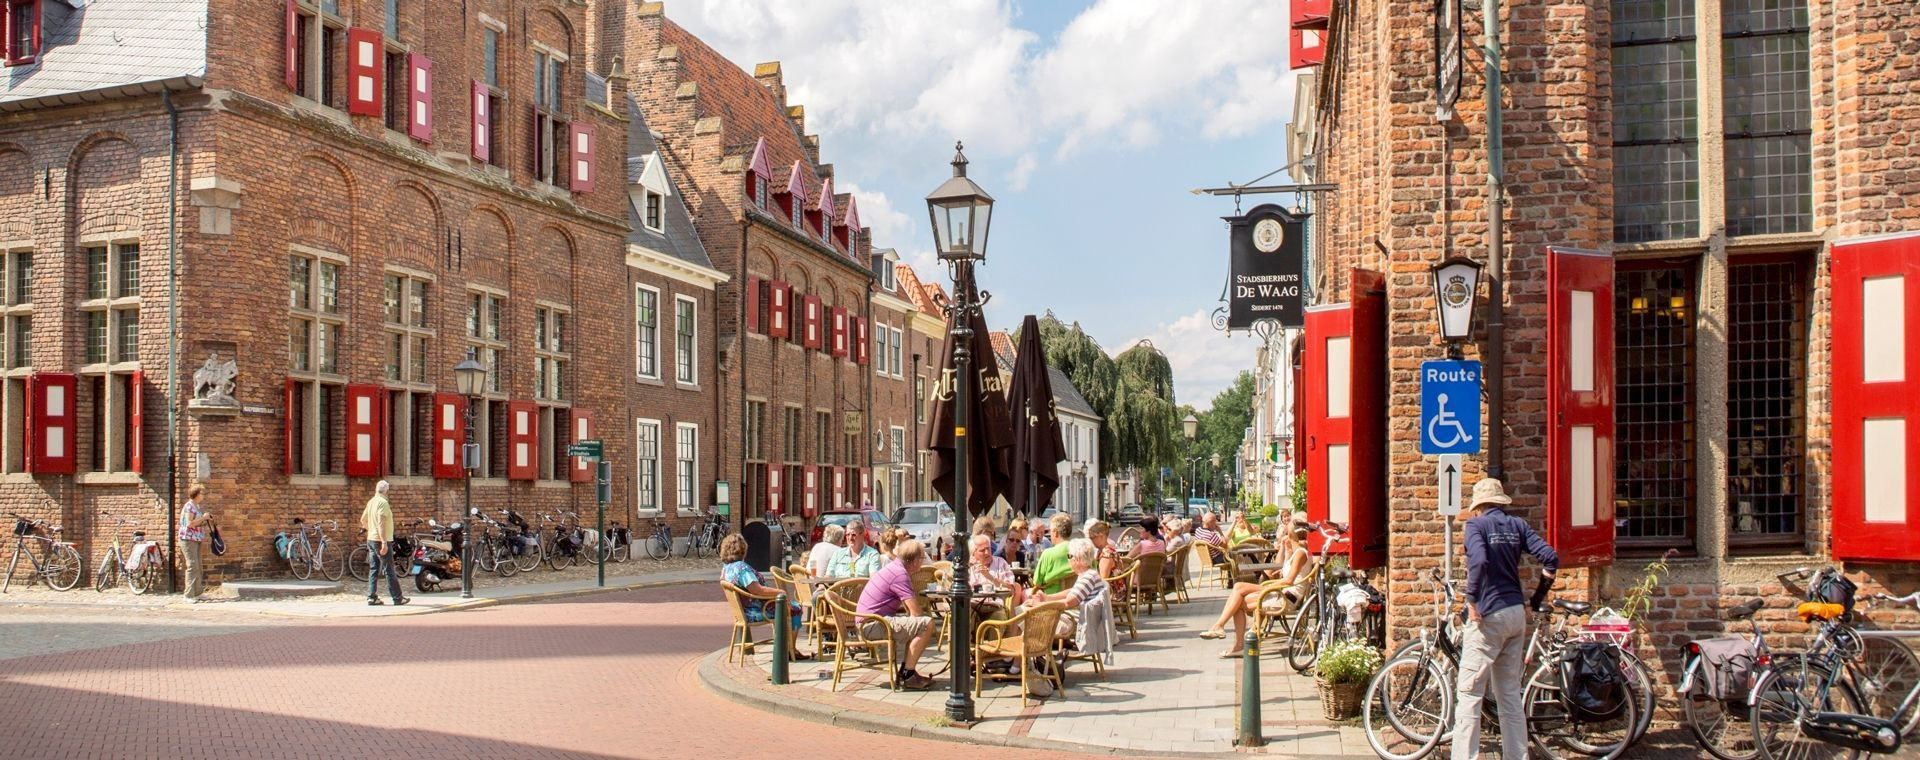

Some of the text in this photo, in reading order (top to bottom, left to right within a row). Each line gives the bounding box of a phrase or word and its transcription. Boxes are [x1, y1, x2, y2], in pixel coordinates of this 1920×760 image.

[1236, 284, 1299, 298] DE WAAG
[1427, 368, 1476, 382] Route
